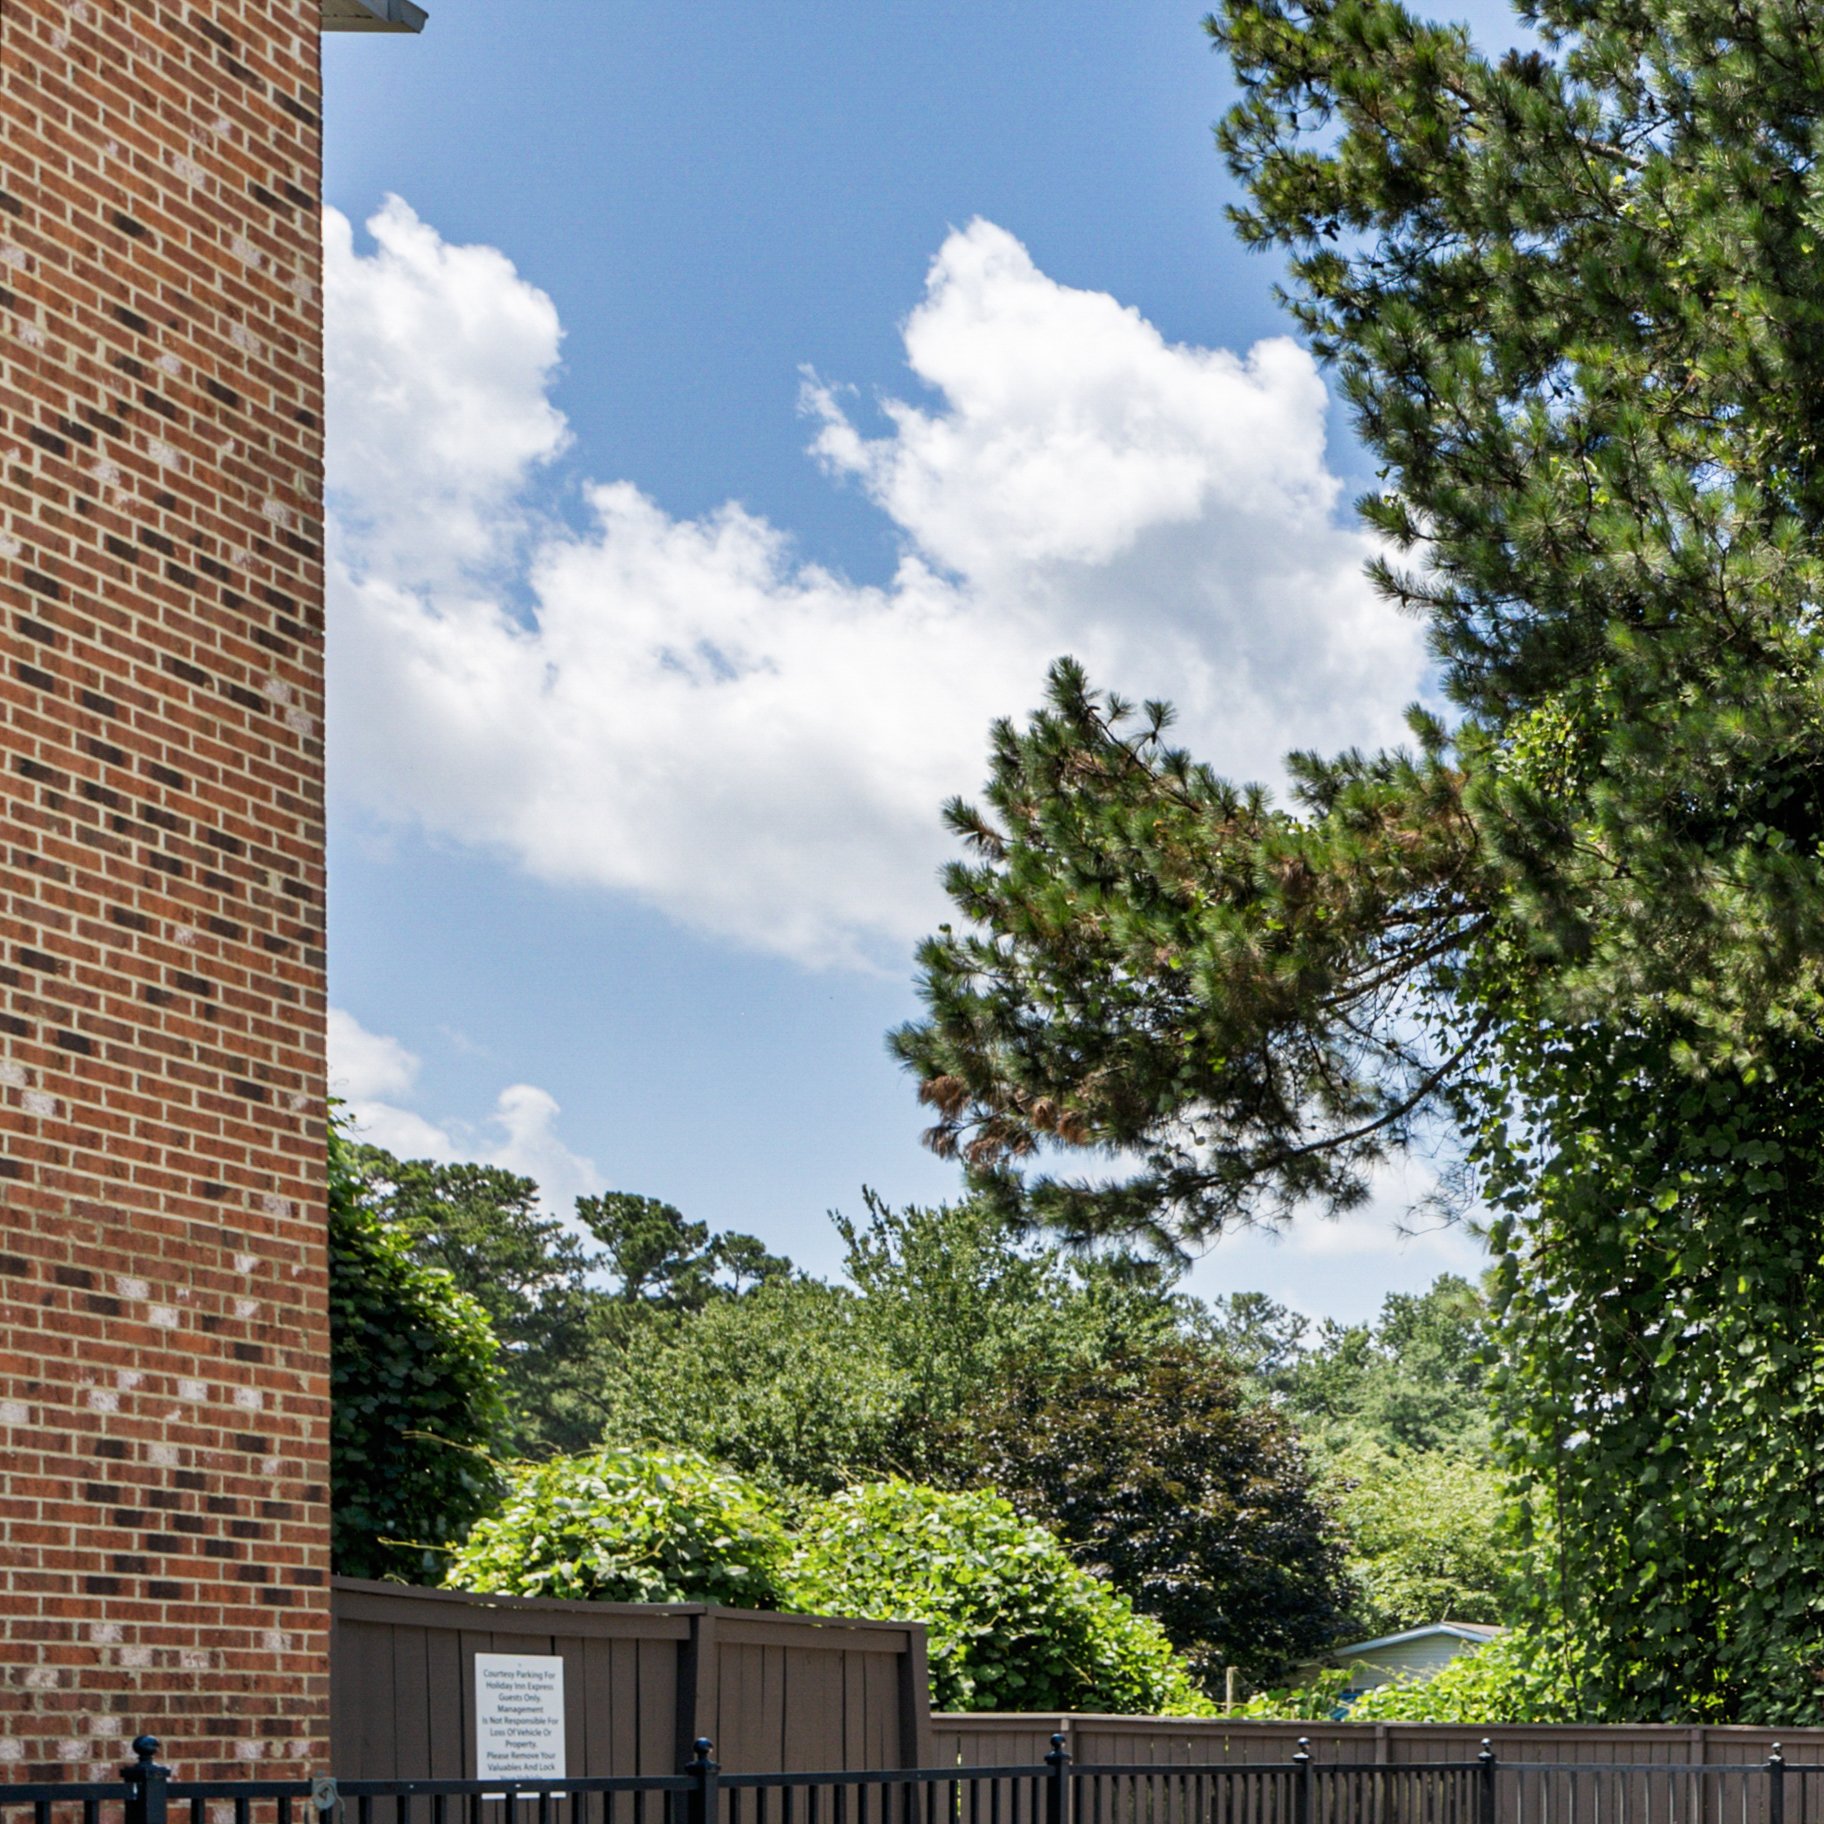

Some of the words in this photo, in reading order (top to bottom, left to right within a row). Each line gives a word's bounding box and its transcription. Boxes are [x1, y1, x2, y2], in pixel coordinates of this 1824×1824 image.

[483, 1669, 514, 1678] Courtesy
[516, 1670, 542, 1679] Parking
[486, 1681, 512, 1690] Holiday
[527, 1683, 553, 1691] Express
[497, 1705, 543, 1714] Management
[504, 1717, 545, 1726] Responsible
[490, 1728, 504, 1736] Loss
[486, 1751, 508, 1759] Please
[488, 1763, 521, 1771] Valuables
